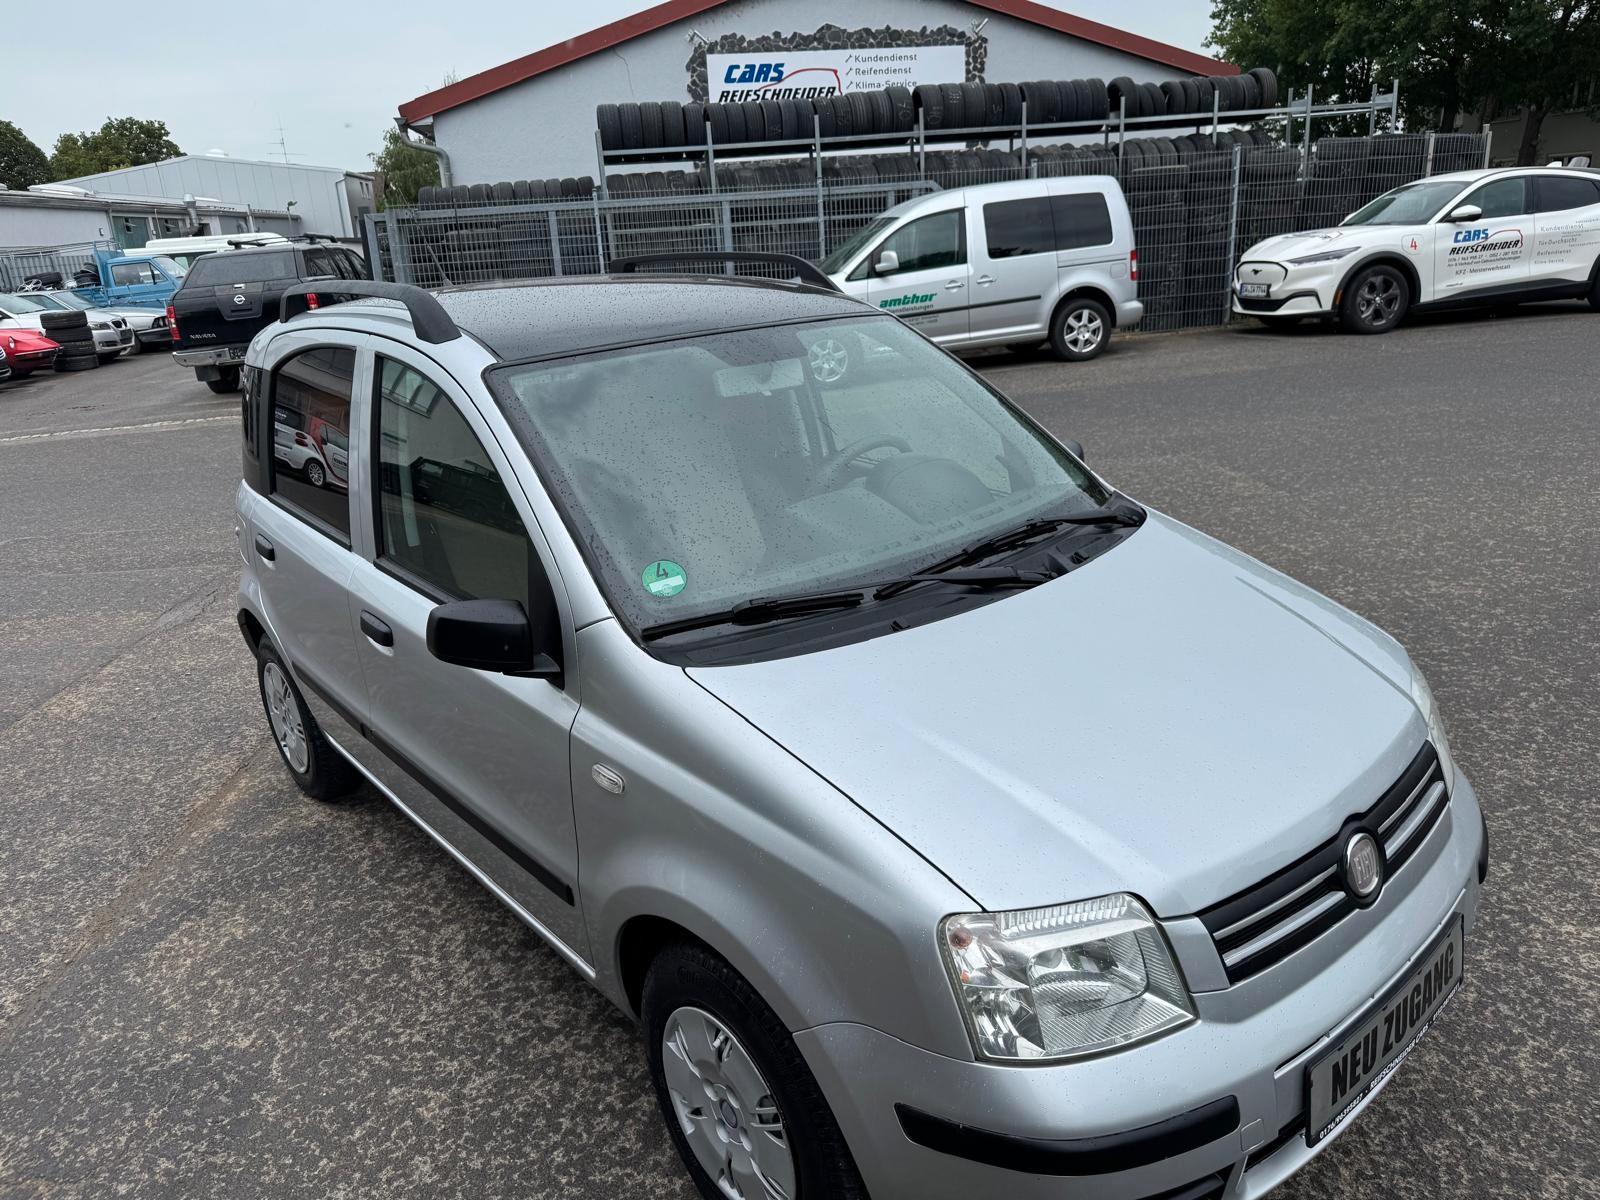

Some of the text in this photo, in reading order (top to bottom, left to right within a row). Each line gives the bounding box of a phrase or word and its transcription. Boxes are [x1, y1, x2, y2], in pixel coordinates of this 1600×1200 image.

[854, 53, 918, 63] Kundendienst
[855, 67, 912, 76] Reifendienst
[855, 79, 917, 90] Klima-Service
[1409, 237, 1418, 250] 4
[1449, 239, 1521, 256] REIFSCHNEIDER
[880, 292, 938, 308] amthor
[656, 562, 669, 578] 4
[1331, 1026, 1378, 1106] NEU
[1381, 941, 1454, 1058] ZUGANG
